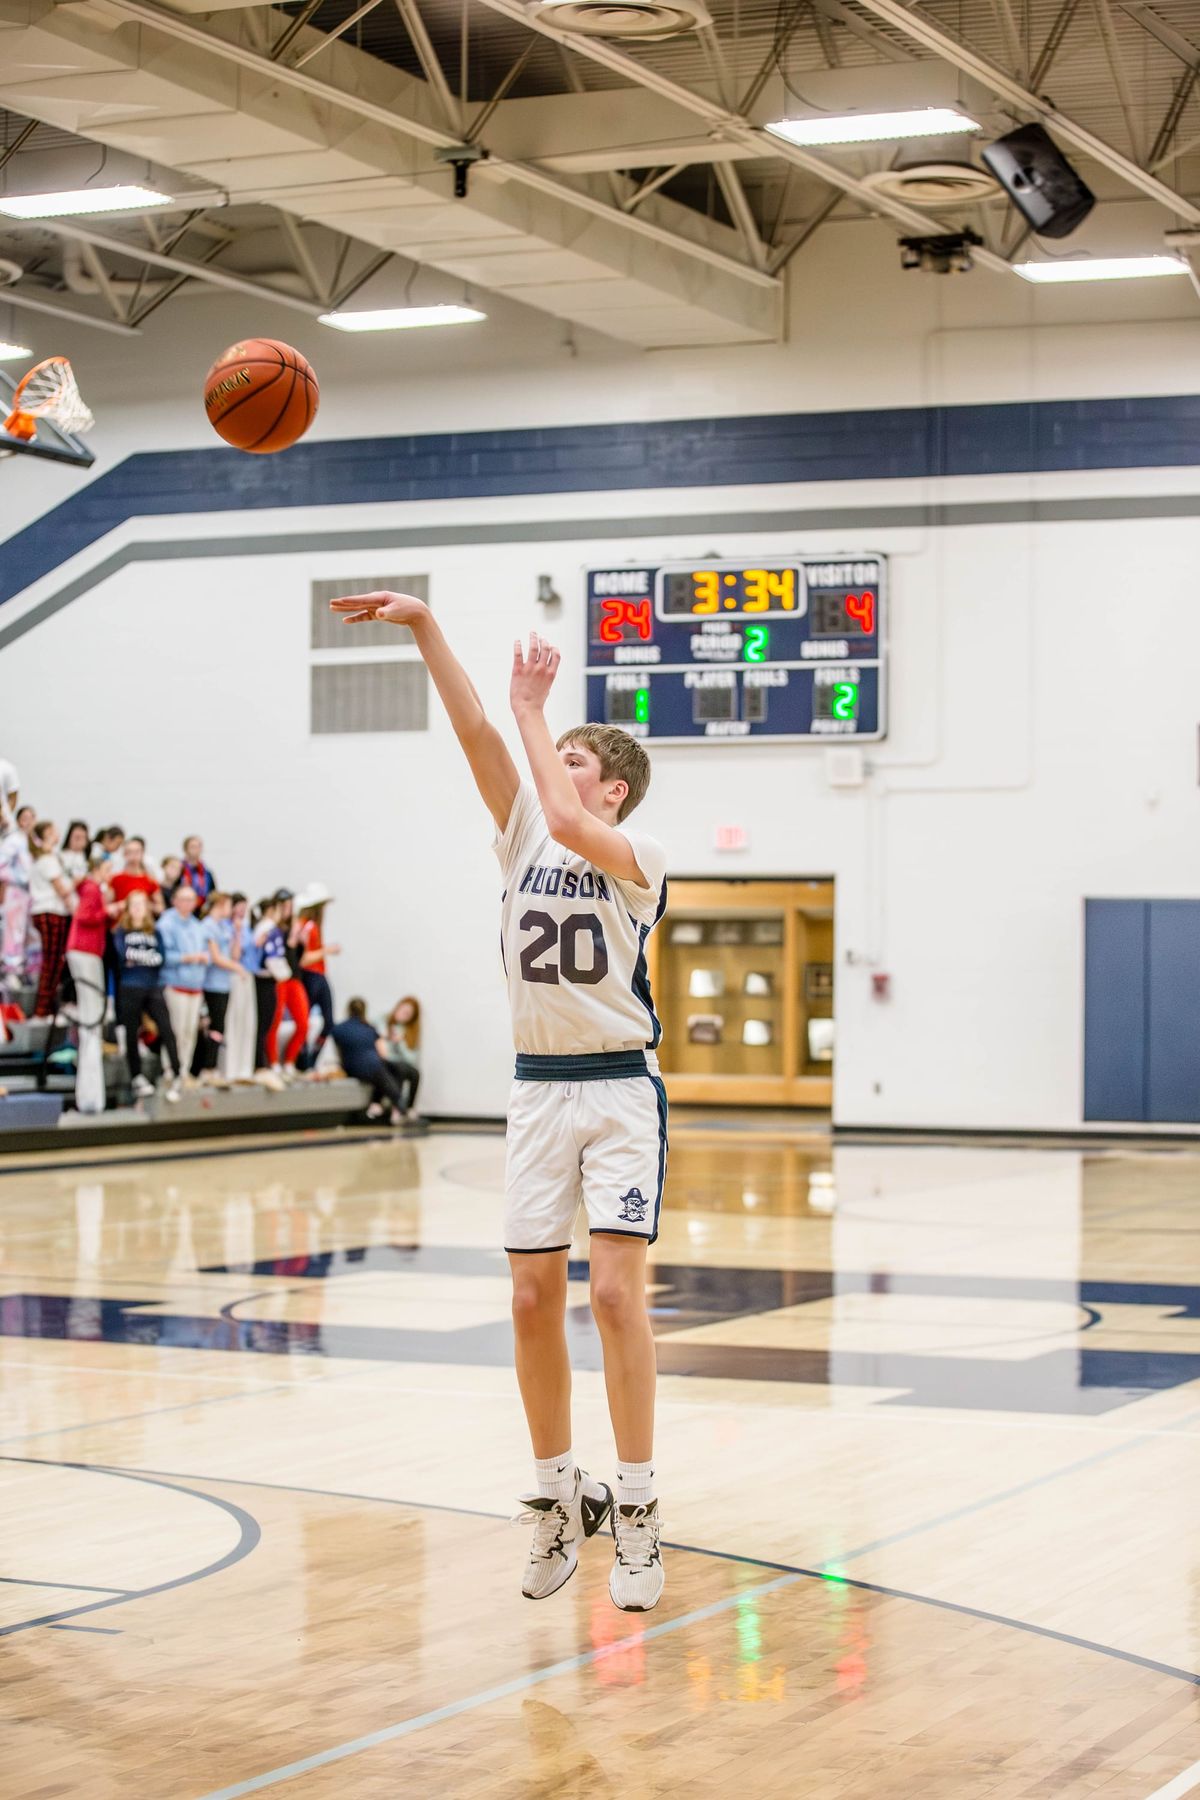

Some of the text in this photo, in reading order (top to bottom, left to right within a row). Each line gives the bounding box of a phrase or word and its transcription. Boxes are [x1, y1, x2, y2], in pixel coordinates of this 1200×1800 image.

[593, 570, 650, 595] HOME
[692, 569, 795, 614] 3:34
[600, 598, 653, 643] 24
[845, 591, 874, 635] 4
[614, 645, 661, 664] BONUS
[744, 624, 769, 662] 2
[800, 640, 849, 659] BONUS
[606, 673, 650, 690] FOULS
[743, 669, 788, 687] FOULS
[635, 687, 649, 723] 1
[832, 681, 858, 720] 2
[518, 864, 613, 903] HUDSON
[519, 909, 609, 985] 20
